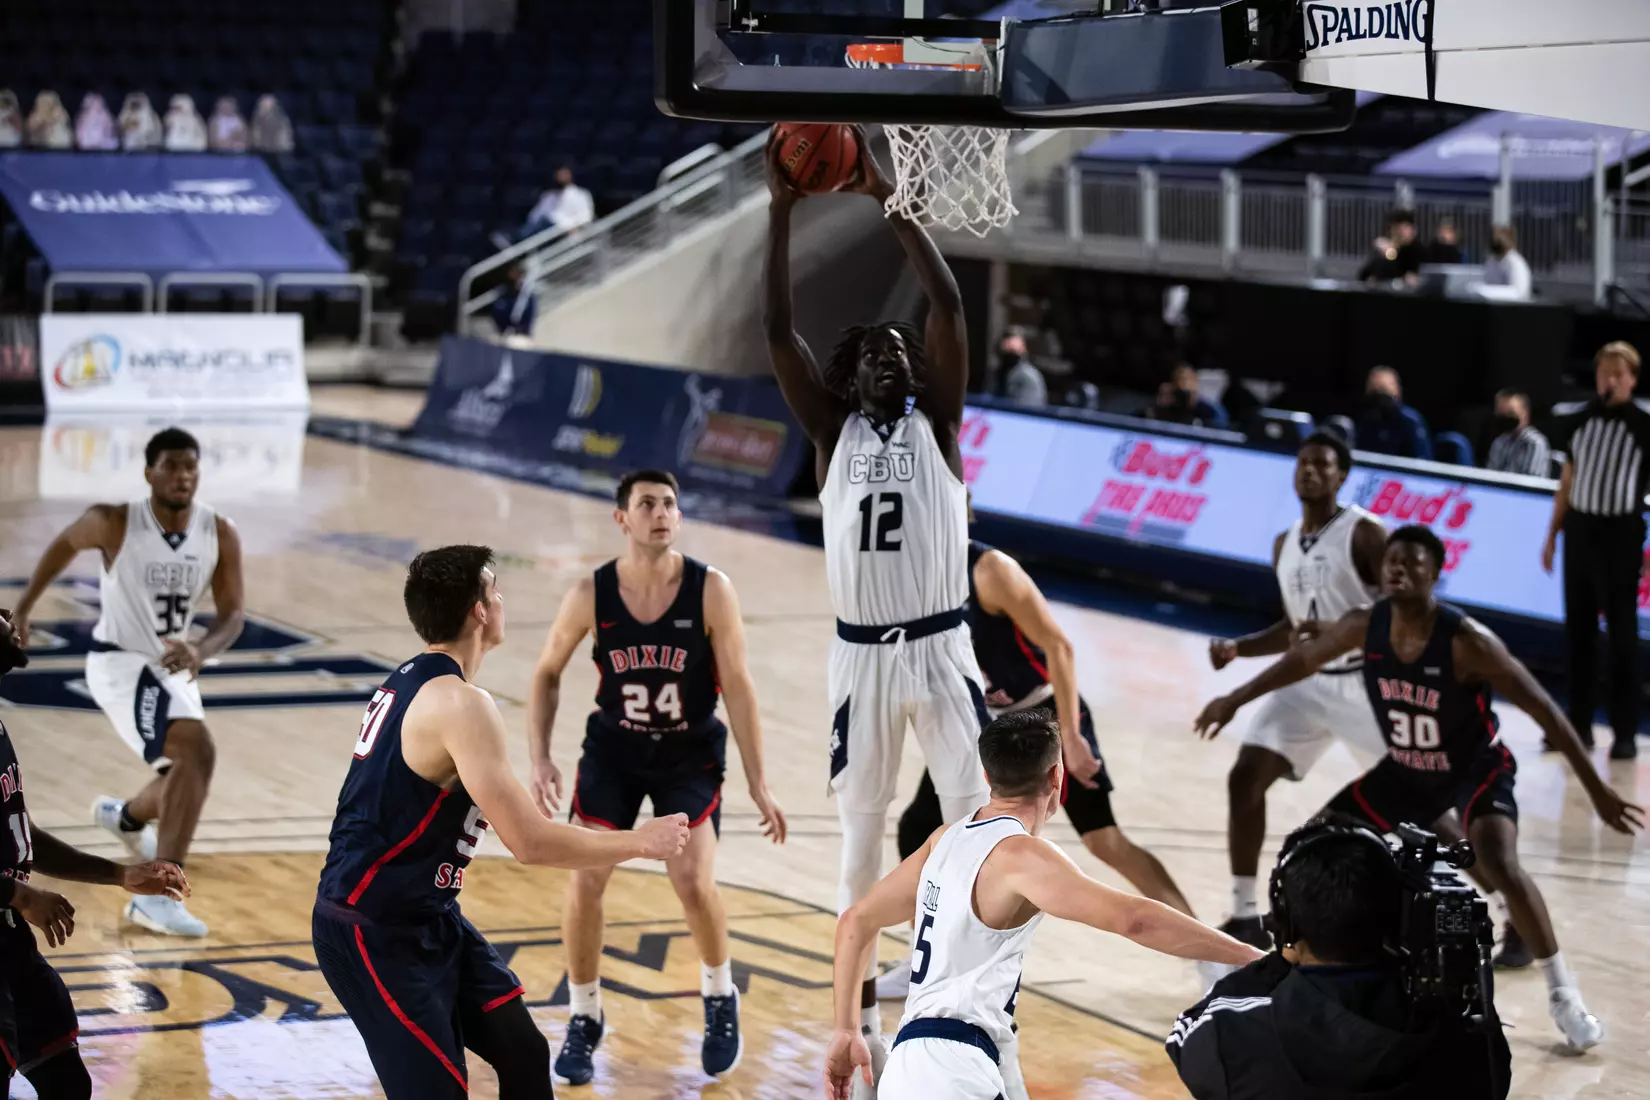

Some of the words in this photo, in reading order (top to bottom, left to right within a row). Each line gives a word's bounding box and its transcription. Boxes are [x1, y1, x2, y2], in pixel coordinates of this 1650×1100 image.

[1307, 0, 1428, 52] SPALDING
[849, 453, 915, 484] CBU
[1121, 441, 1212, 485] Bud's
[859, 492, 903, 551] 12
[1368, 480, 1473, 529] Bud's
[155, 594, 190, 636] 35
[609, 644, 688, 674] DIXIE
[621, 683, 682, 723] 24
[1378, 677, 1441, 712] DIXIE
[1387, 709, 1441, 750] 30
[910, 913, 934, 985] 5
